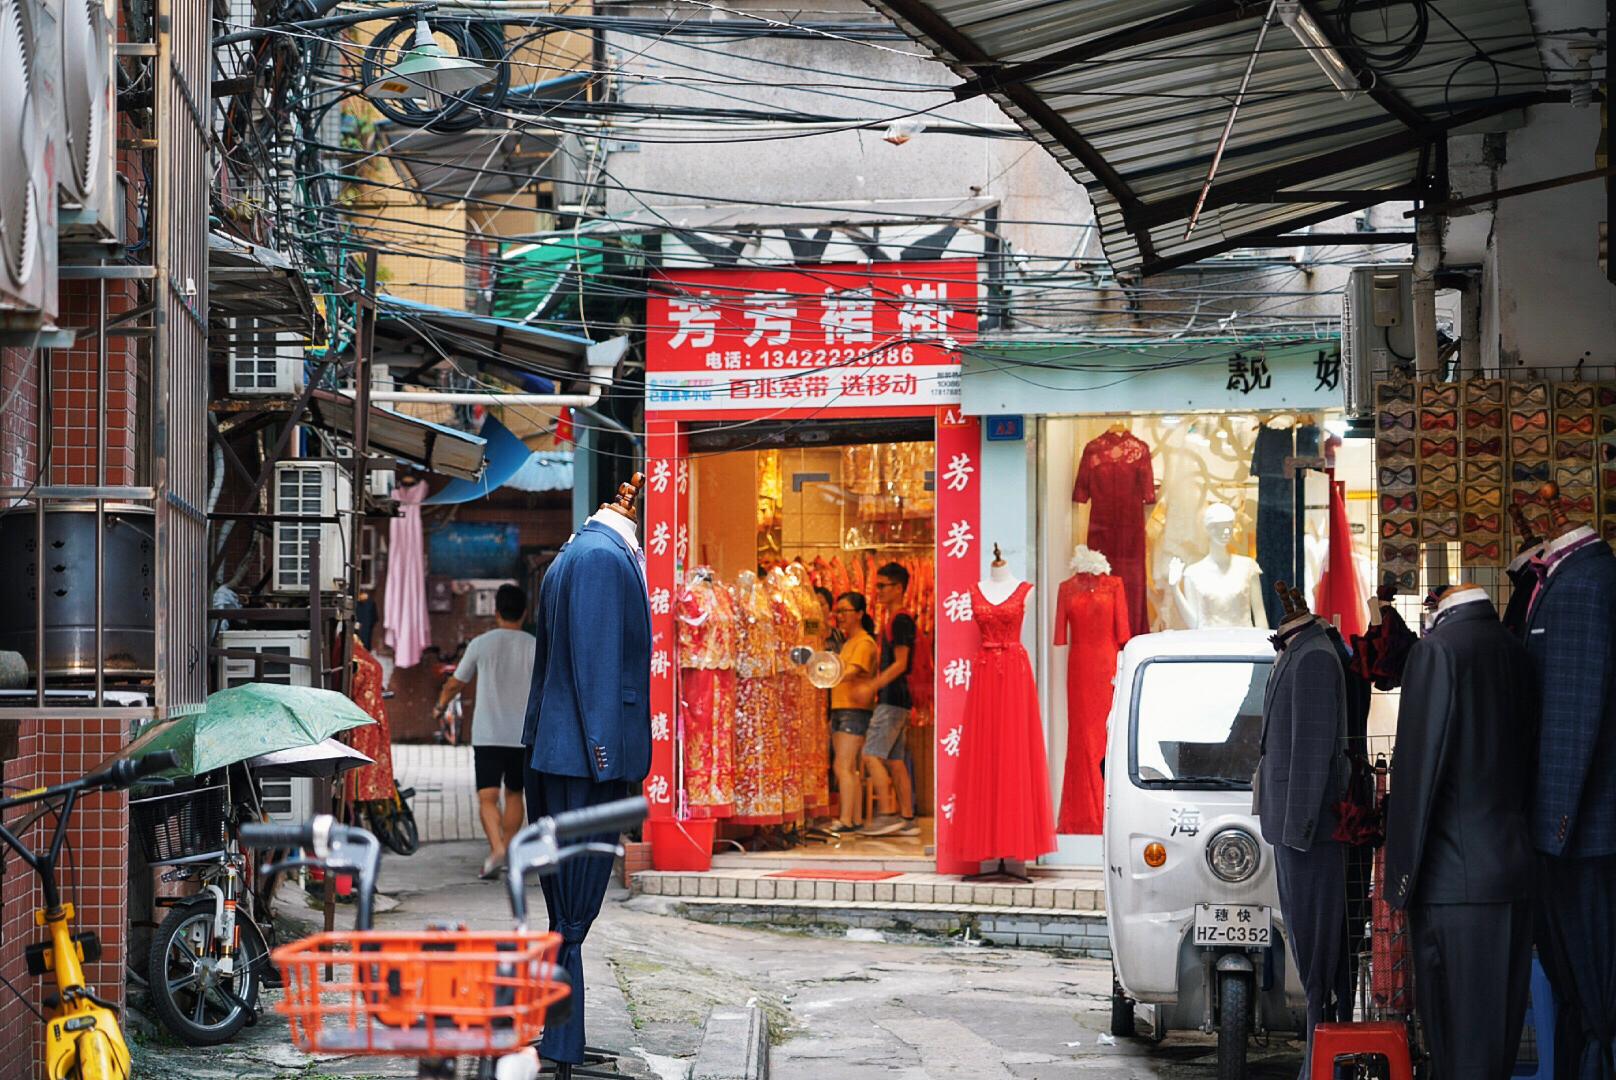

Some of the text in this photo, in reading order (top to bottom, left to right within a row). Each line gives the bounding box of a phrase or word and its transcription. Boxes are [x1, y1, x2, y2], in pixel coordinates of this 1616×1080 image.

[668, 283, 955, 350] 芳芳裙褂
[729, 374, 917, 399] 百兆宽带 选移动
[943, 409, 966, 425] A2
[1170, 808, 1200, 837] 海
[1197, 926, 1268, 942] HZ-C352
